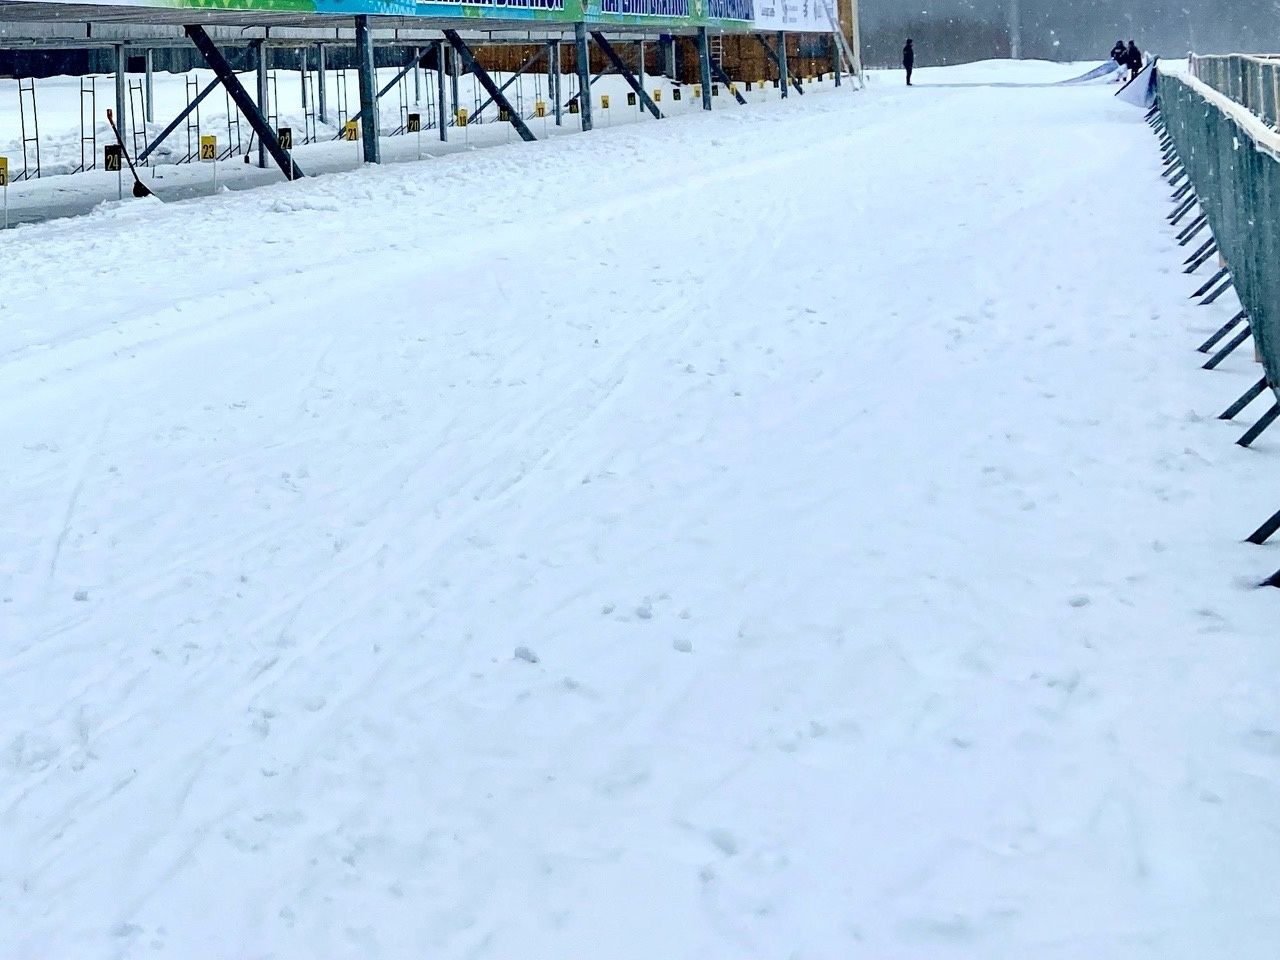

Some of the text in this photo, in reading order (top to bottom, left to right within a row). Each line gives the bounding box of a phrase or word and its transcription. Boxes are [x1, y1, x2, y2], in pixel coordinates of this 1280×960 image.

[347, 128, 357, 140] 21
[279, 136, 292, 149] 22
[202, 144, 215, 159] 23
[107, 154, 119, 170] 24
